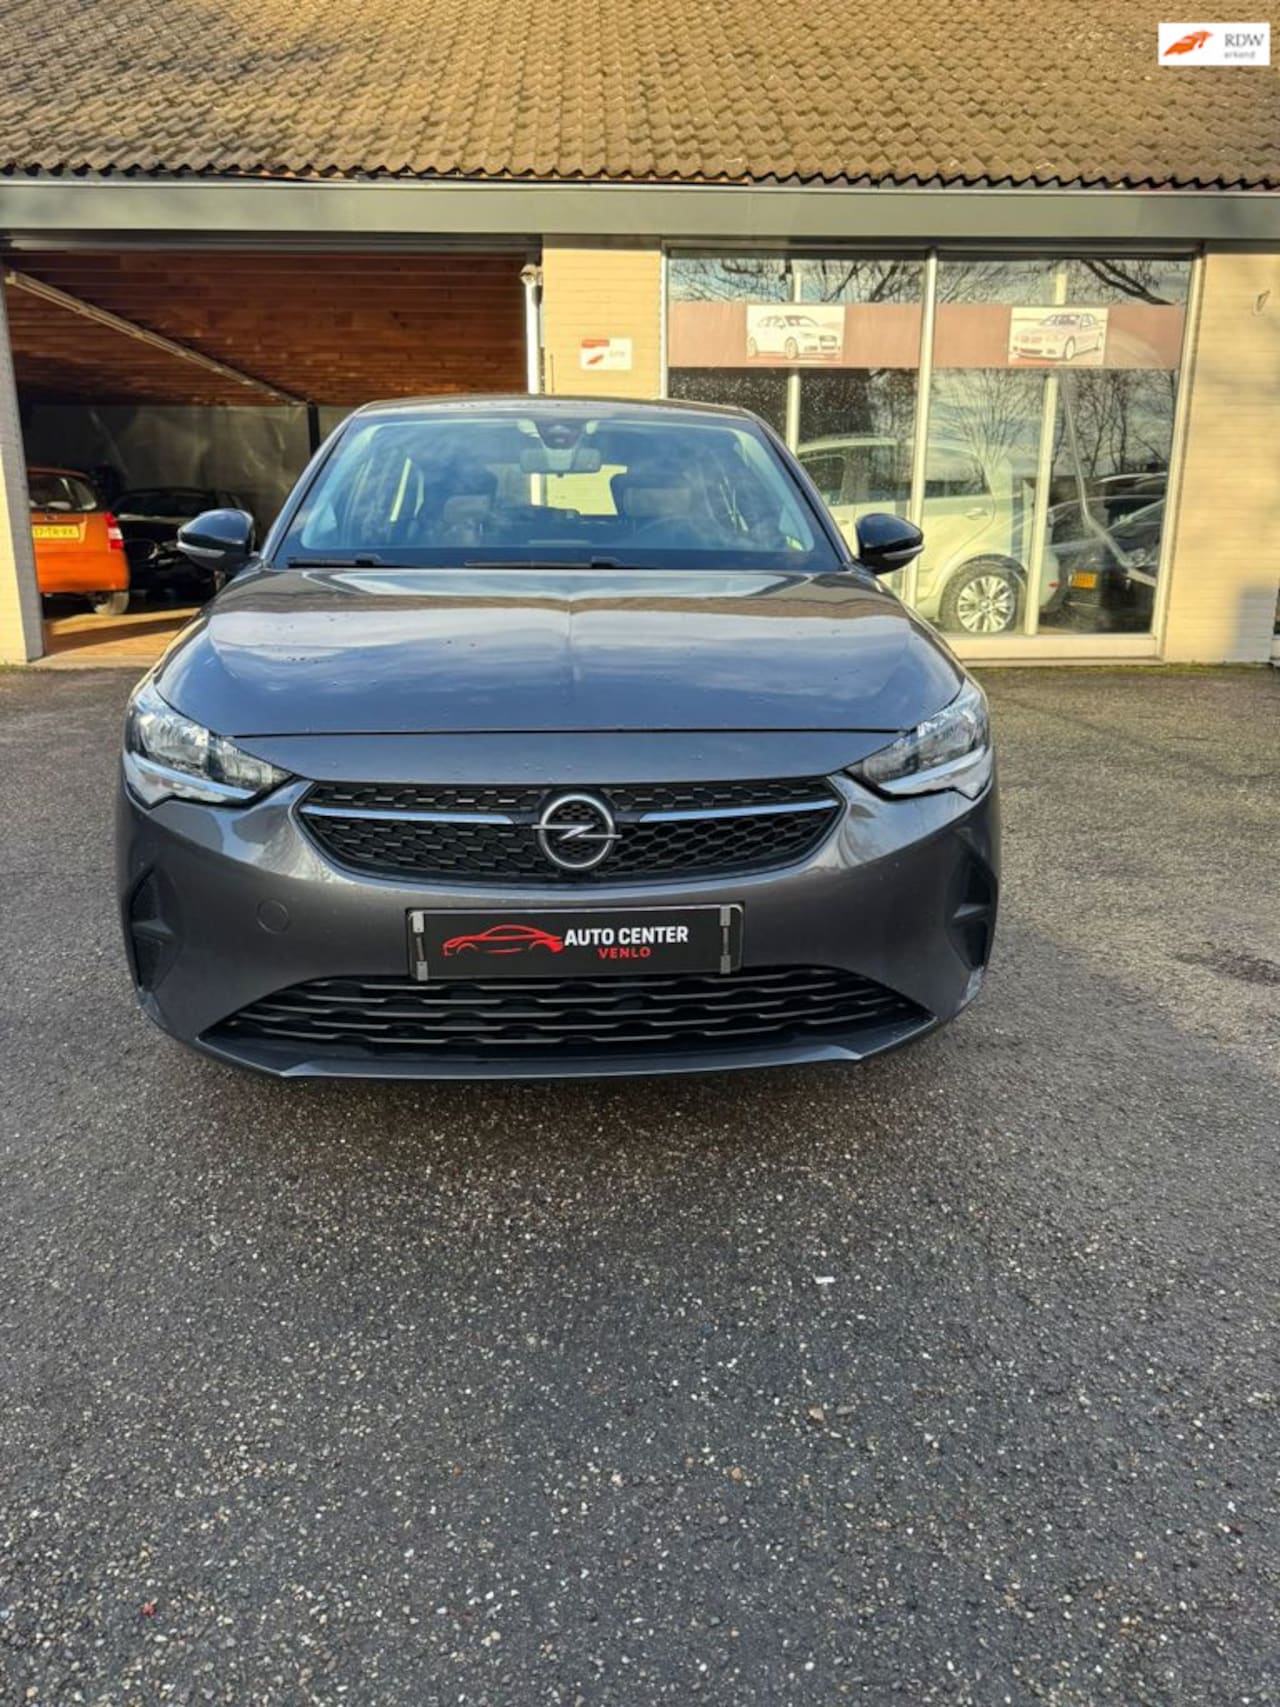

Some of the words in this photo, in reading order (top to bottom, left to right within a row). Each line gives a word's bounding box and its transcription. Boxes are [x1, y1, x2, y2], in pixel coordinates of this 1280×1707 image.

[564, 928, 615, 947] AUTO
[618, 926, 689, 945] CENTER
[598, 947, 652, 959] VENLO
